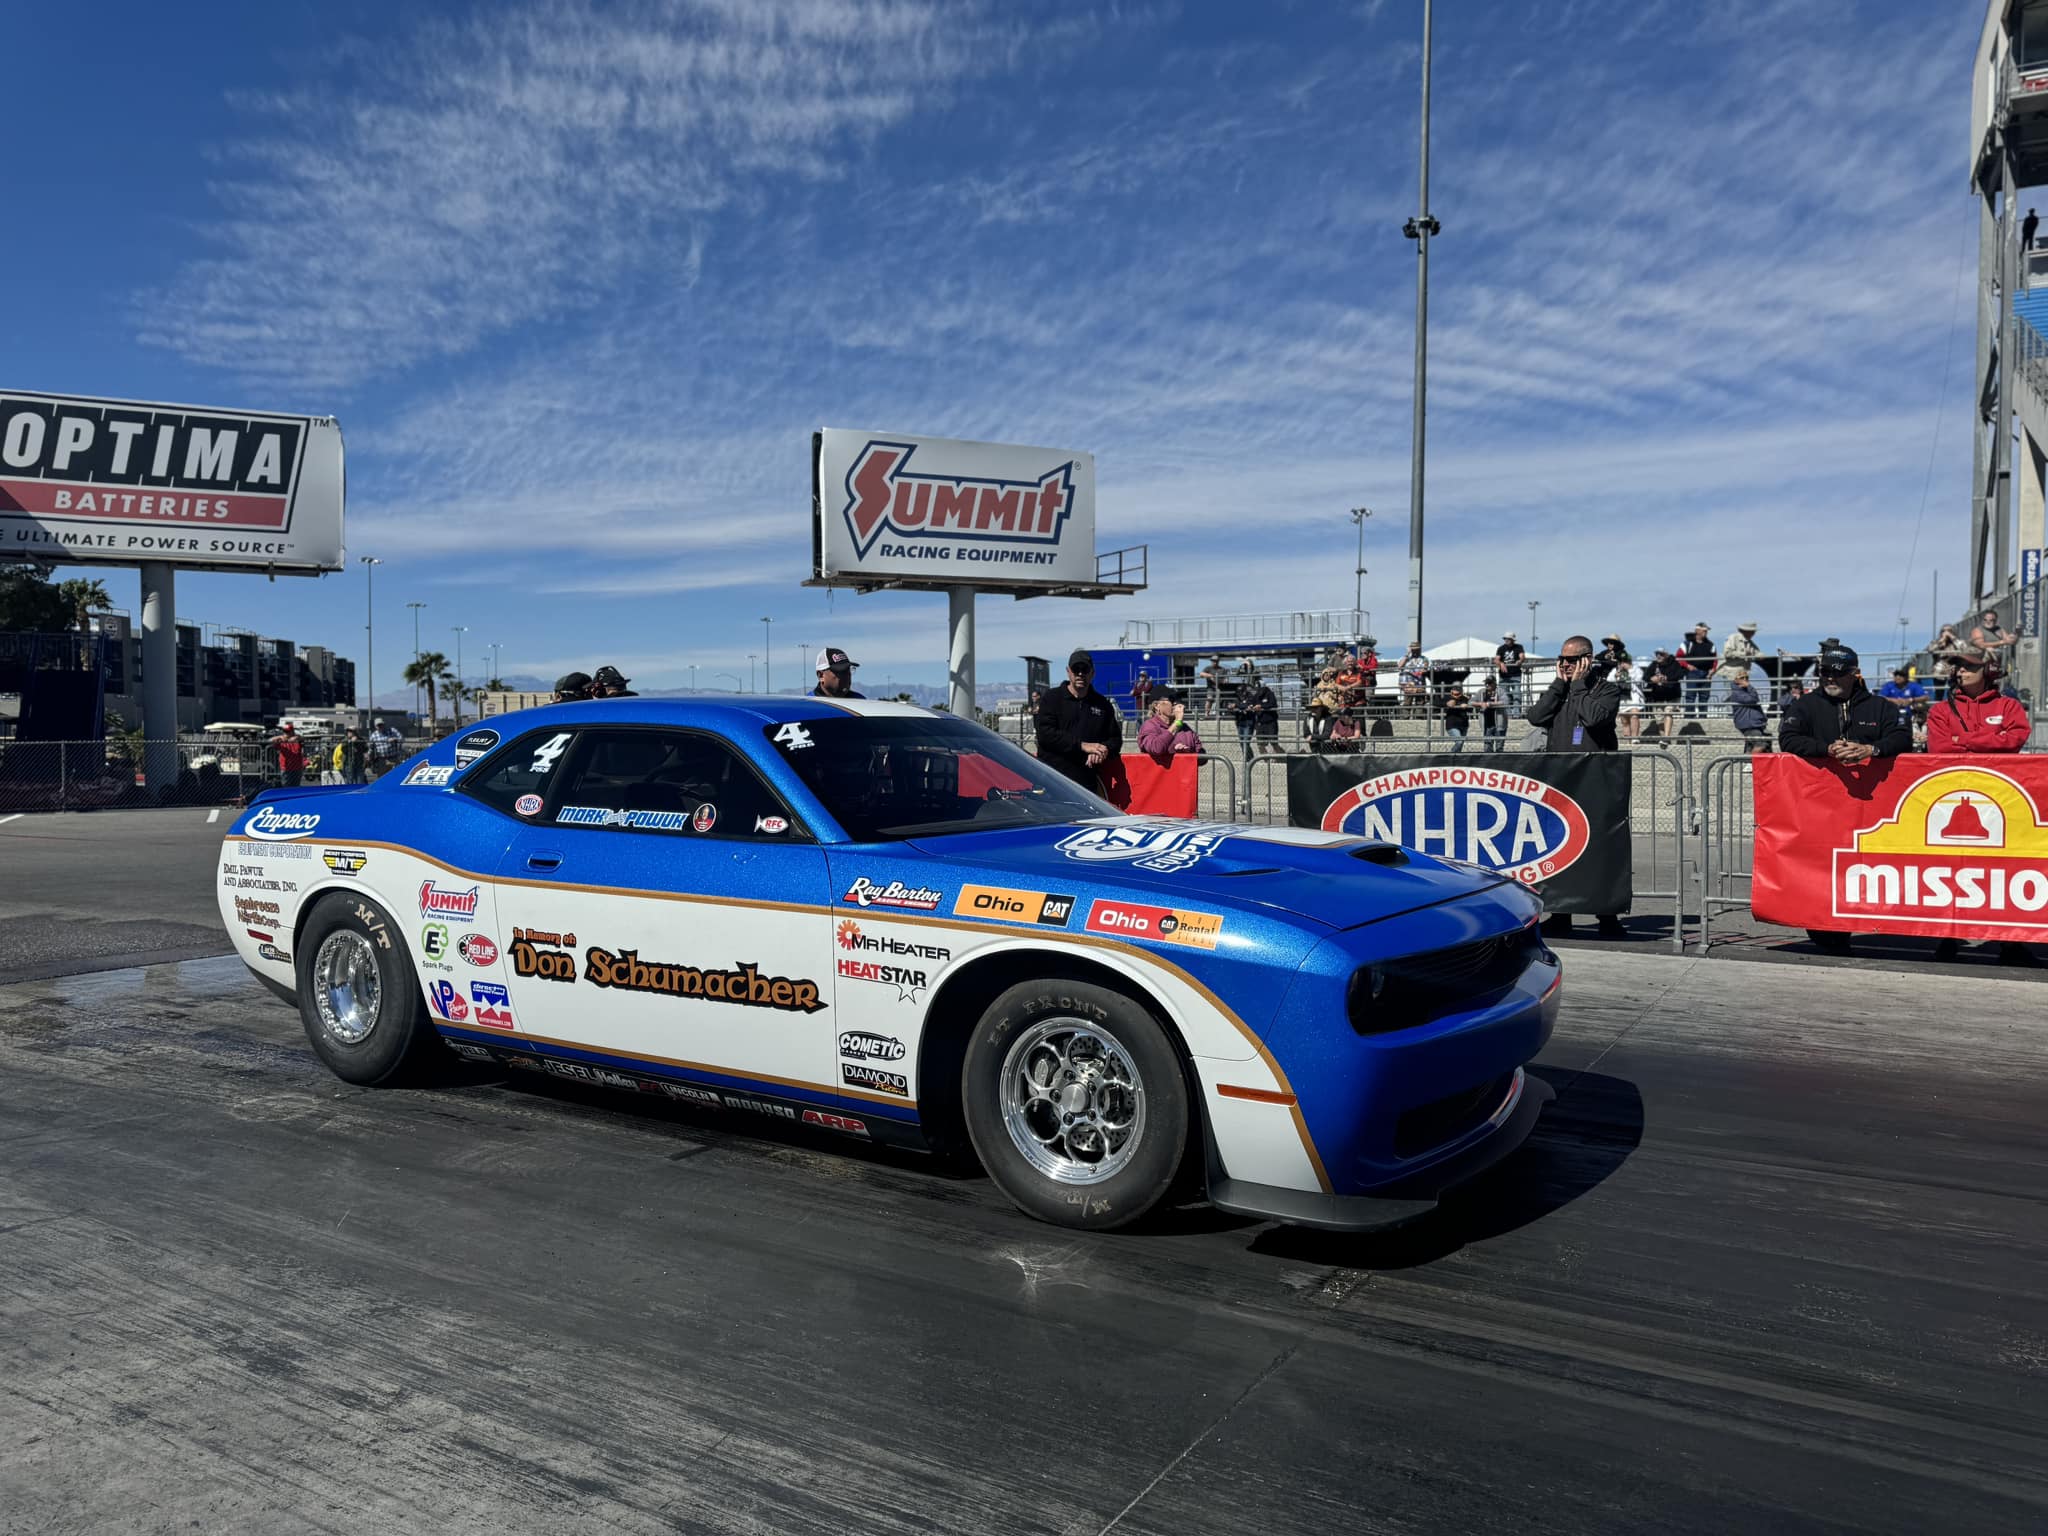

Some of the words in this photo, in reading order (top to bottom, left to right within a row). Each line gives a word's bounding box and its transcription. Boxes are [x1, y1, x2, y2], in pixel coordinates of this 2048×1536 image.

[2, 412, 282, 485] OPTIMA
[54, 490, 229, 518] BATTERIES
[16, 529, 117, 547] ULTIMATE
[127, 537, 199, 557] POWER
[210, 541, 286, 555] SOURCE
[880, 544, 950, 560] RACING
[956, 548, 1057, 565] EQUIPMENT
[2023, 610, 2035, 636] Food
[533, 733, 572, 768] 4
[1362, 769, 1540, 798] CHAMPIONSHIP
[519, 797, 540, 812] NHRA
[245, 806, 321, 841] Empaco
[764, 819, 783, 829] RFC
[1364, 792, 1549, 867] NHRA
[223, 863, 239, 875] EMIL
[223, 876, 237, 887] AND
[848, 877, 886, 907] Ray
[882, 881, 942, 902] Barton
[427, 913, 445, 921] RACING
[974, 894, 1025, 913] Ohio
[1042, 900, 1070, 919] CAT
[354, 903, 391, 950] M/T
[1099, 909, 1149, 930] Ohio
[1161, 919, 1177, 929] CAT
[1179, 922, 1216, 935] Rental
[468, 943, 481, 955] RED
[513, 927, 523, 940] In
[526, 928, 561, 946] Memory
[881, 937, 951, 961] HEATER
[422, 961, 438, 971] Spark
[438, 962, 454, 973] Plugs
[510, 940, 577, 981] Don
[429, 979, 454, 1020] VP
[1022, 995, 1108, 1020] FRONT
[840, 1033, 905, 1059] COMETIC
[844, 1064, 906, 1088] DIAMOND
[544, 1059, 596, 1081] JESEL
[664, 1084, 710, 1100] LINCOLN
[803, 1109, 866, 1132] ARP
